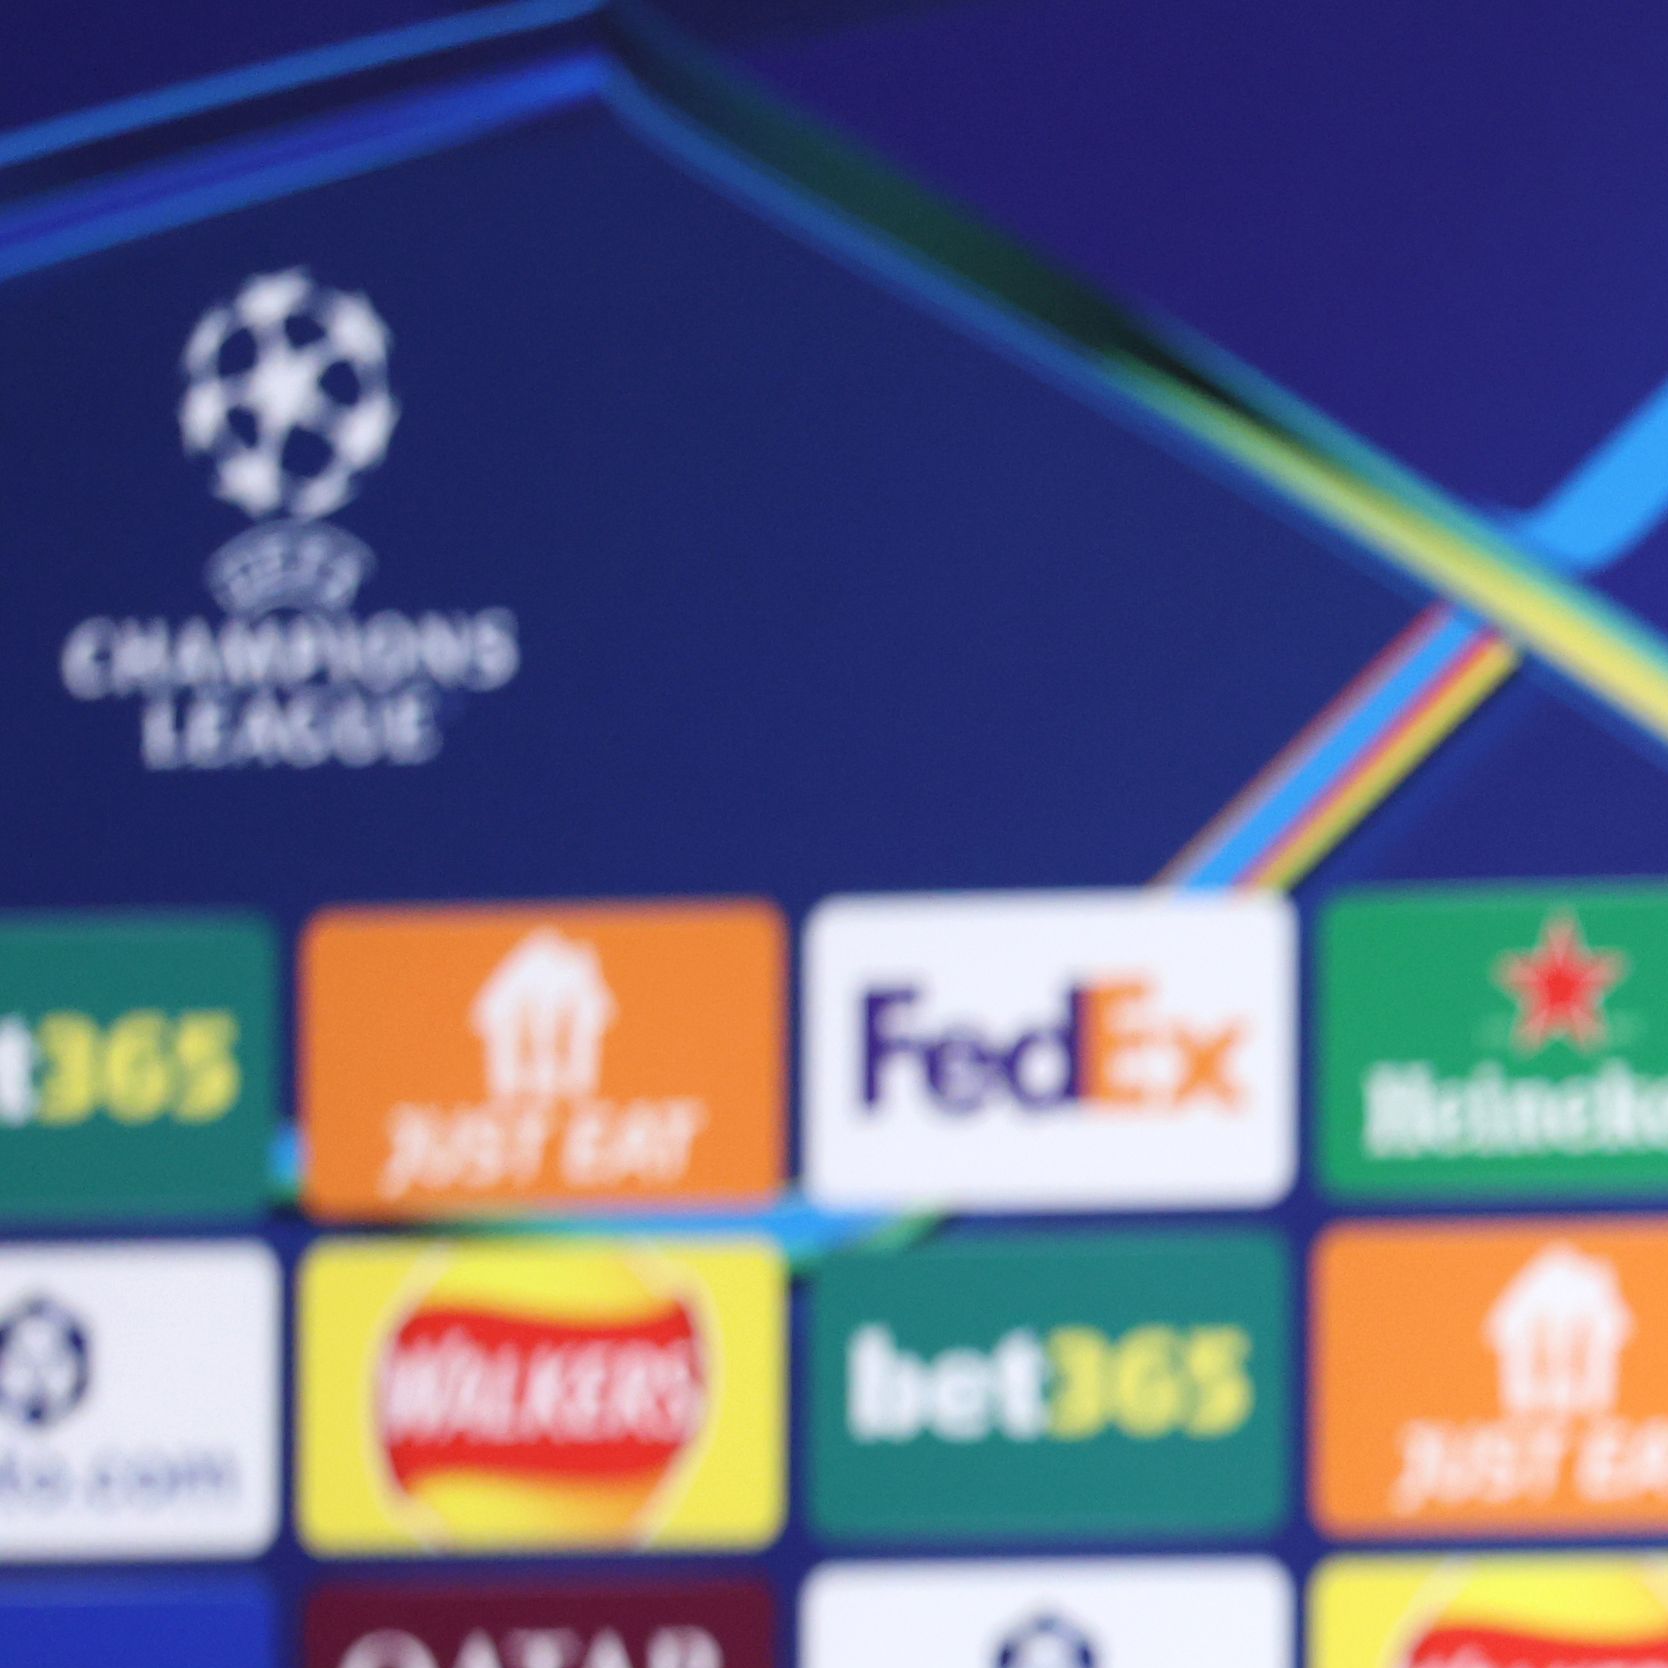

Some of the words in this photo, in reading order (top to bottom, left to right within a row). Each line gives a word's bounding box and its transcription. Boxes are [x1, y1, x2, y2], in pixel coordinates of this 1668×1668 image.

[62, 610, 520, 702] CHAMPIONS
[142, 690, 440, 770] LEAGUE
[858, 975, 1247, 1115] FedEx
[846, 1322, 1254, 1442] bet365
